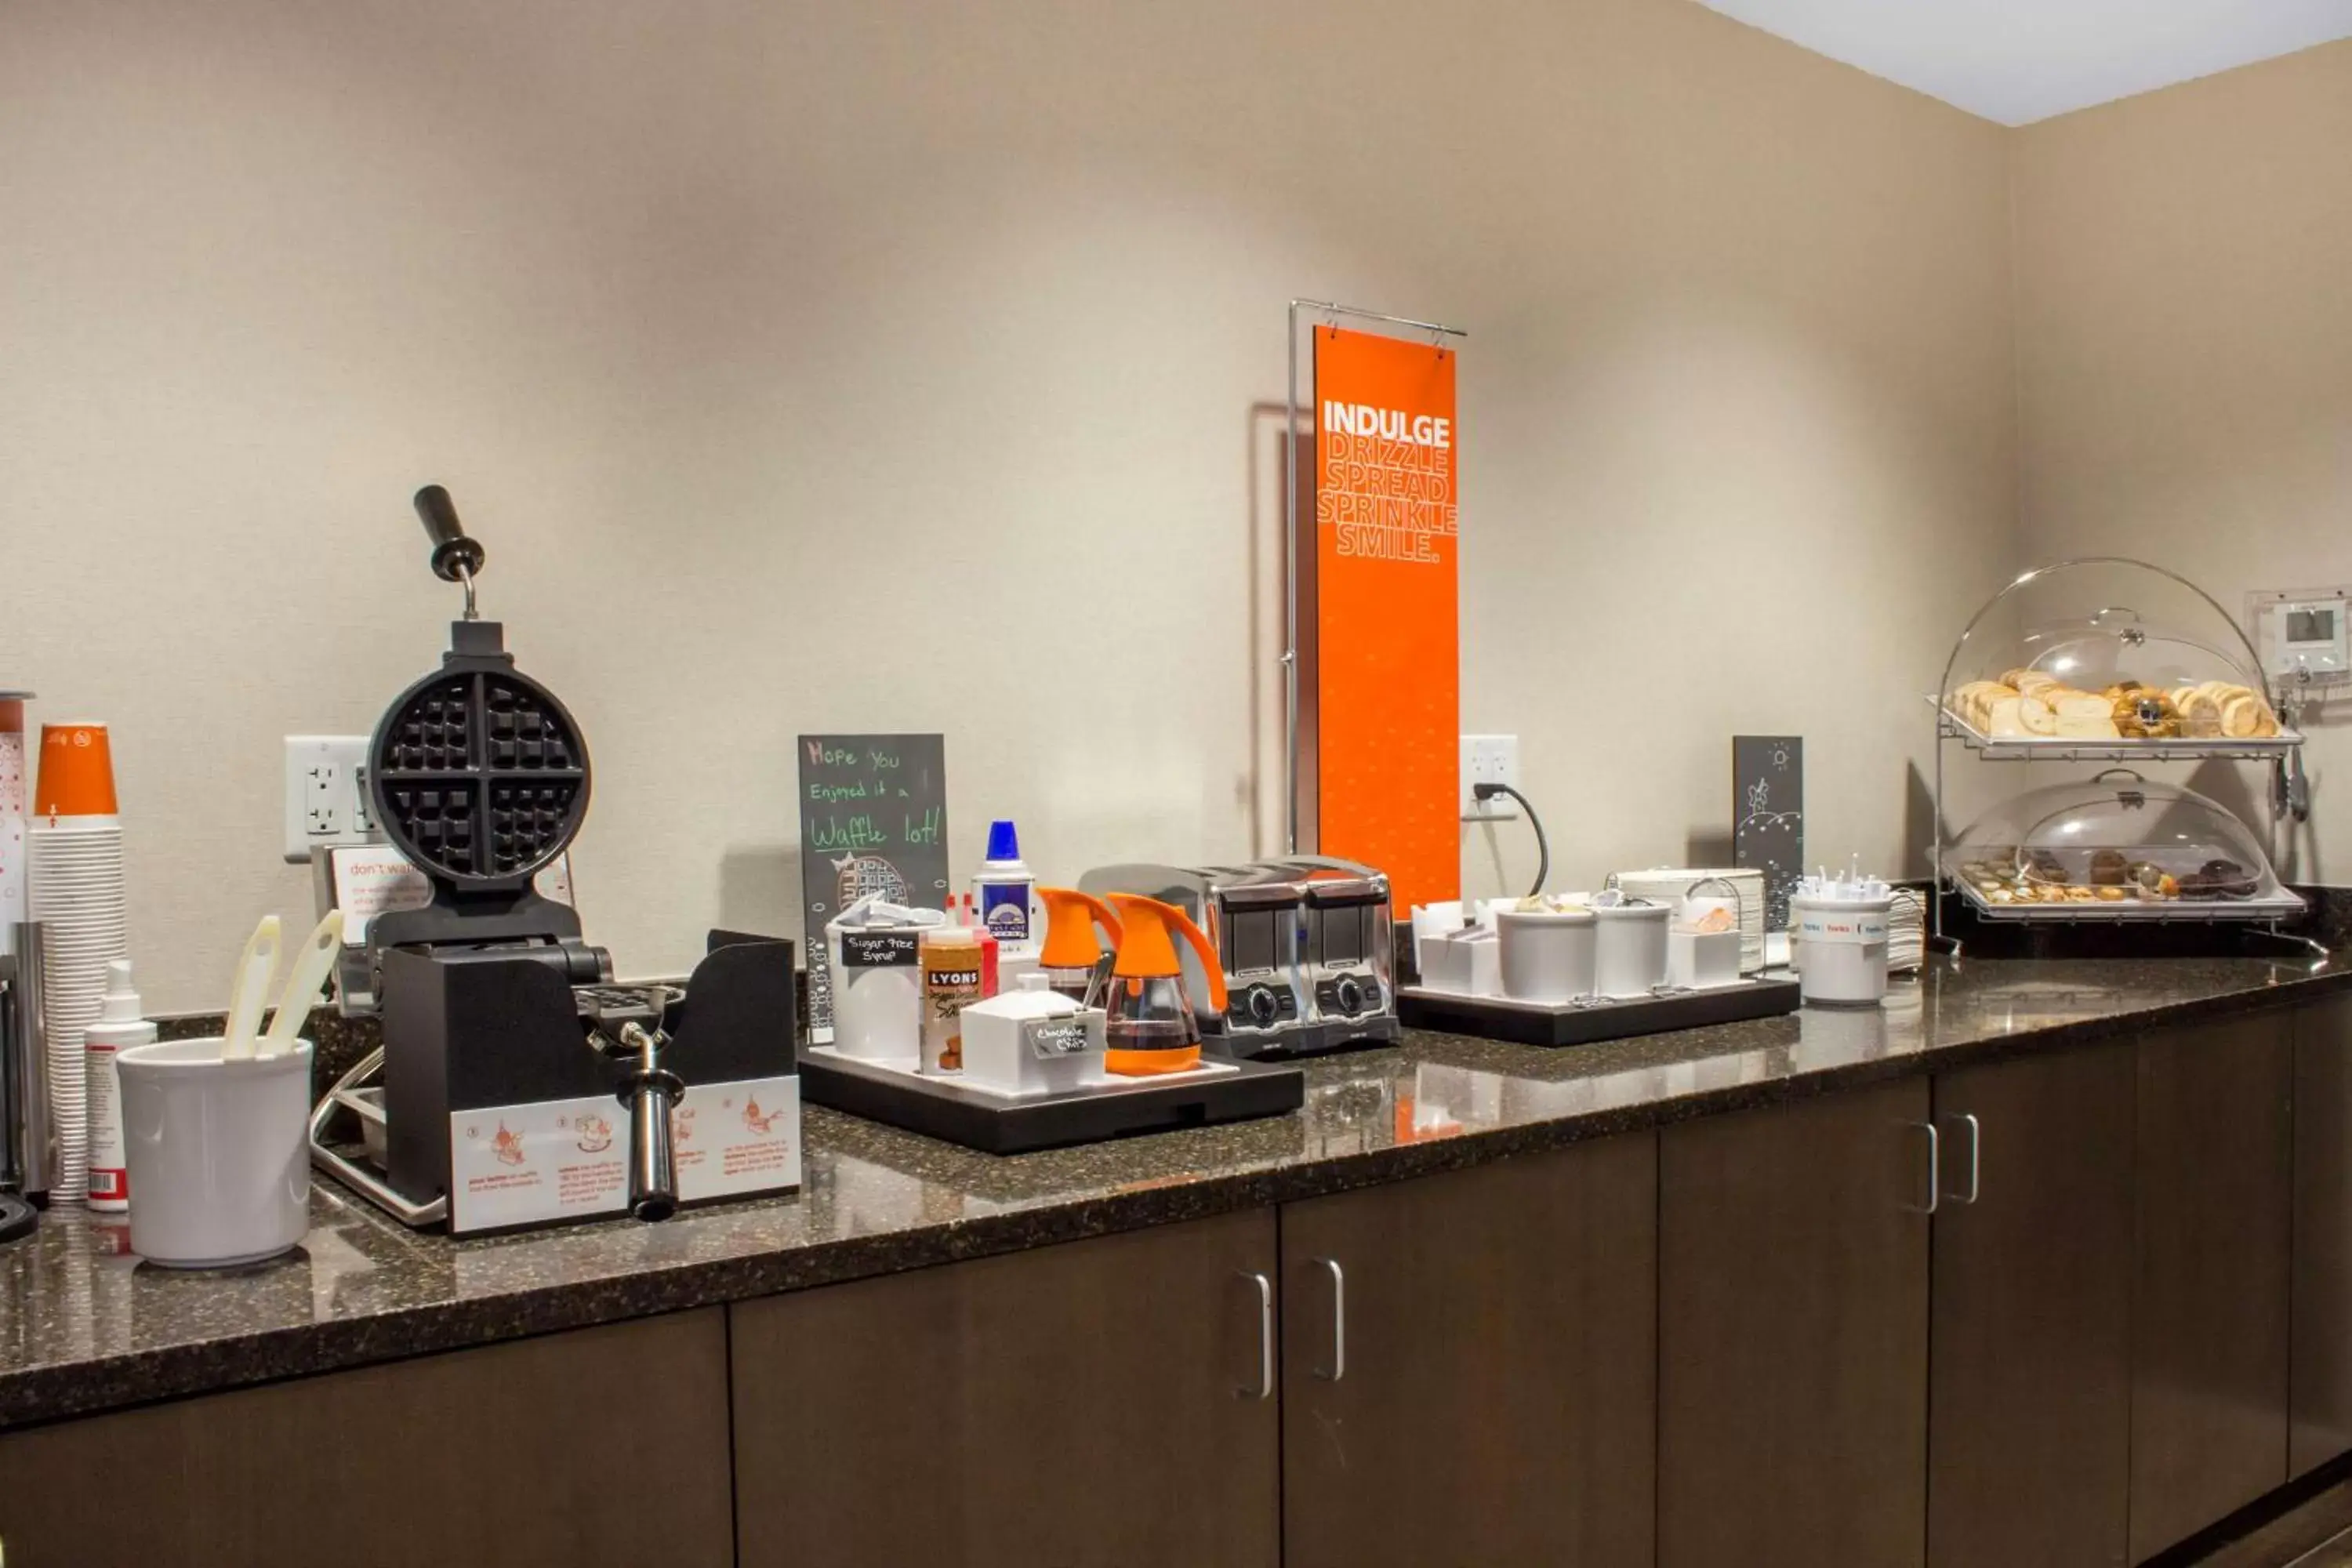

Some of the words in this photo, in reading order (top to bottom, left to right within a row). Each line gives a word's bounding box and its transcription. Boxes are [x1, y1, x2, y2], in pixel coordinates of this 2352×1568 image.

[1323, 400, 1450, 448] INDULGE
[1327, 430, 1449, 477] DRIZZLE
[1326, 459, 1450, 504] SPREAD
[1317, 488, 1458, 536] SPRINKLE
[1336, 523, 1440, 564] SMILE.
[807, 740, 858, 766] Hope
[870, 750, 899, 771] You
[810, 779, 866, 804] Enjoyed
[811, 813, 887, 849] Waffle
[905, 804, 940, 845] lot!
[931, 972, 978, 985] LYONS
